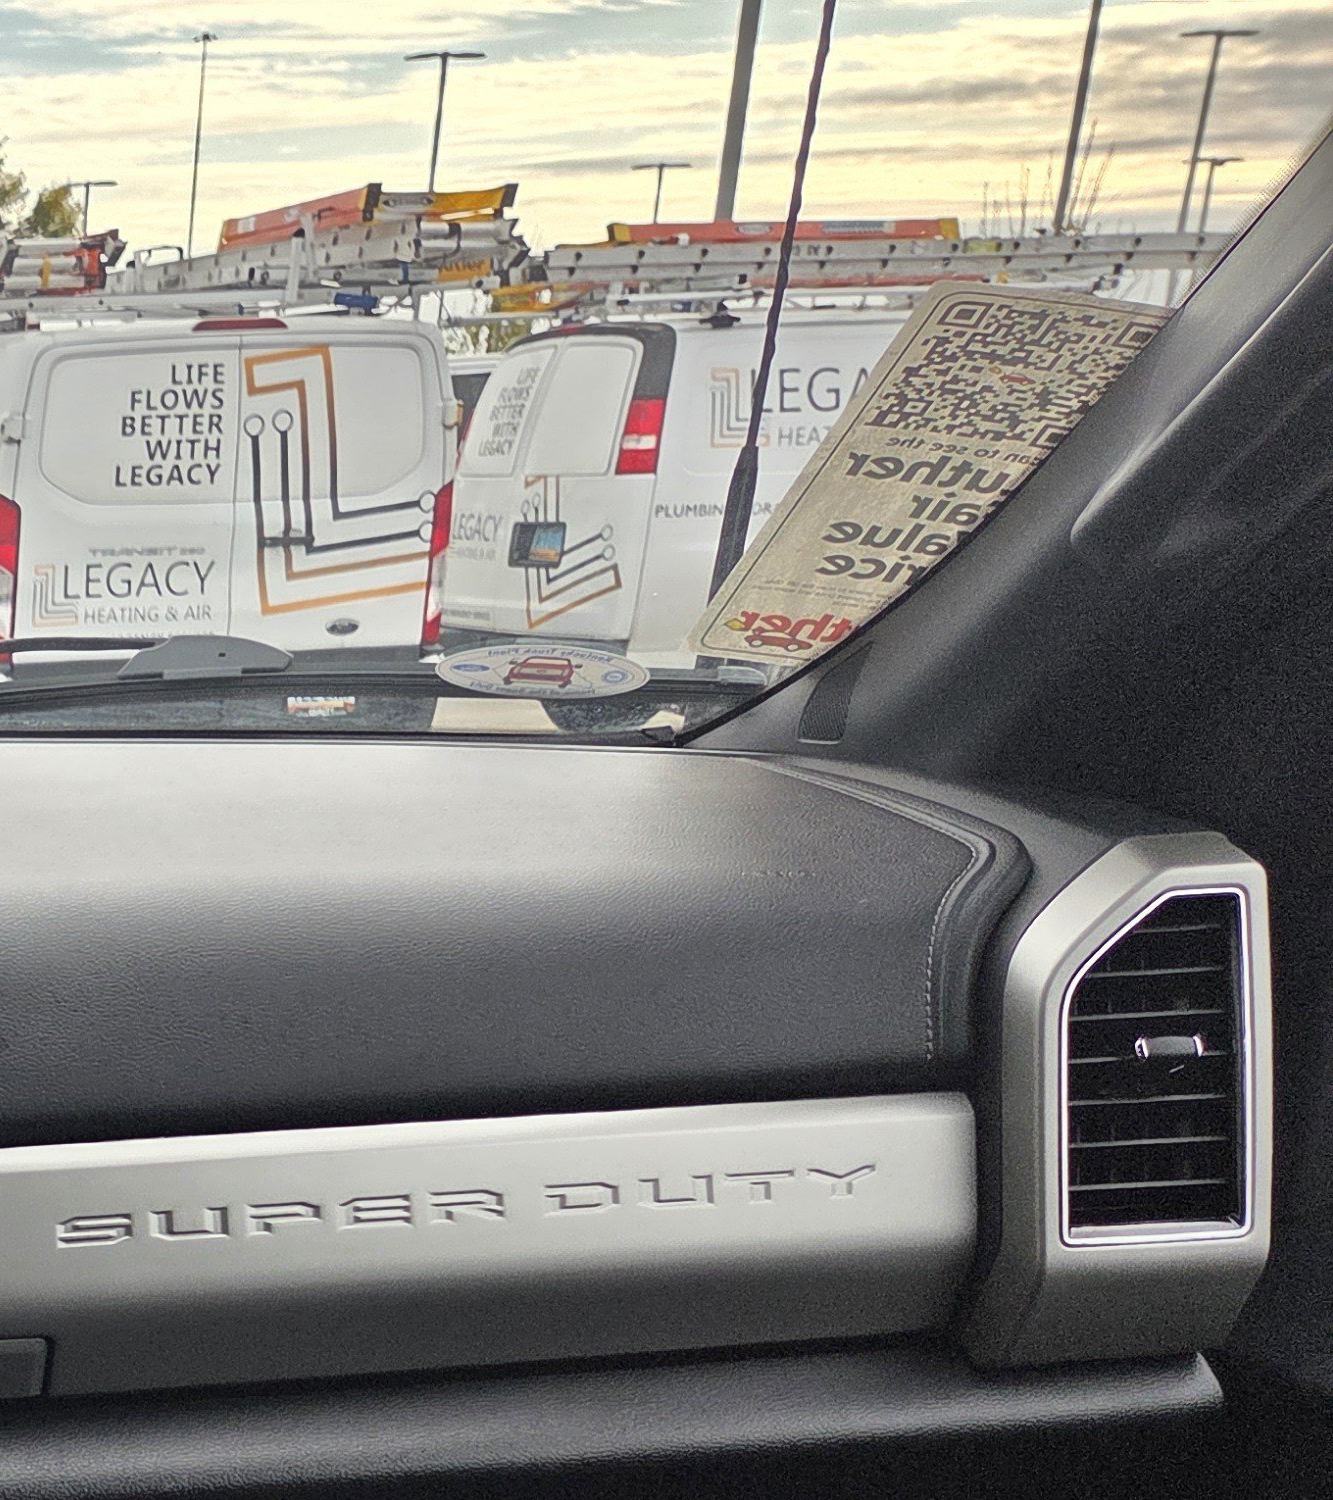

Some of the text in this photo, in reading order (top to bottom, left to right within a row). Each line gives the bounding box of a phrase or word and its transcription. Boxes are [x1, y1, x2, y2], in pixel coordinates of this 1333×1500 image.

[171, 363, 225, 386] LIFE
[130, 388, 224, 412] FLOWS
[121, 413, 223, 437] BETTER
[145, 437, 221, 461] WITH
[115, 463, 221, 487] LEGACY
[654, 502, 725, 519] PLUMBIN
[451, 512, 503, 542] LEGACY
[63, 560, 215, 599] LEGACY
[84, 604, 213, 625] HEATING & AIR
[55, 1163, 878, 1249] SUPER DUTY
